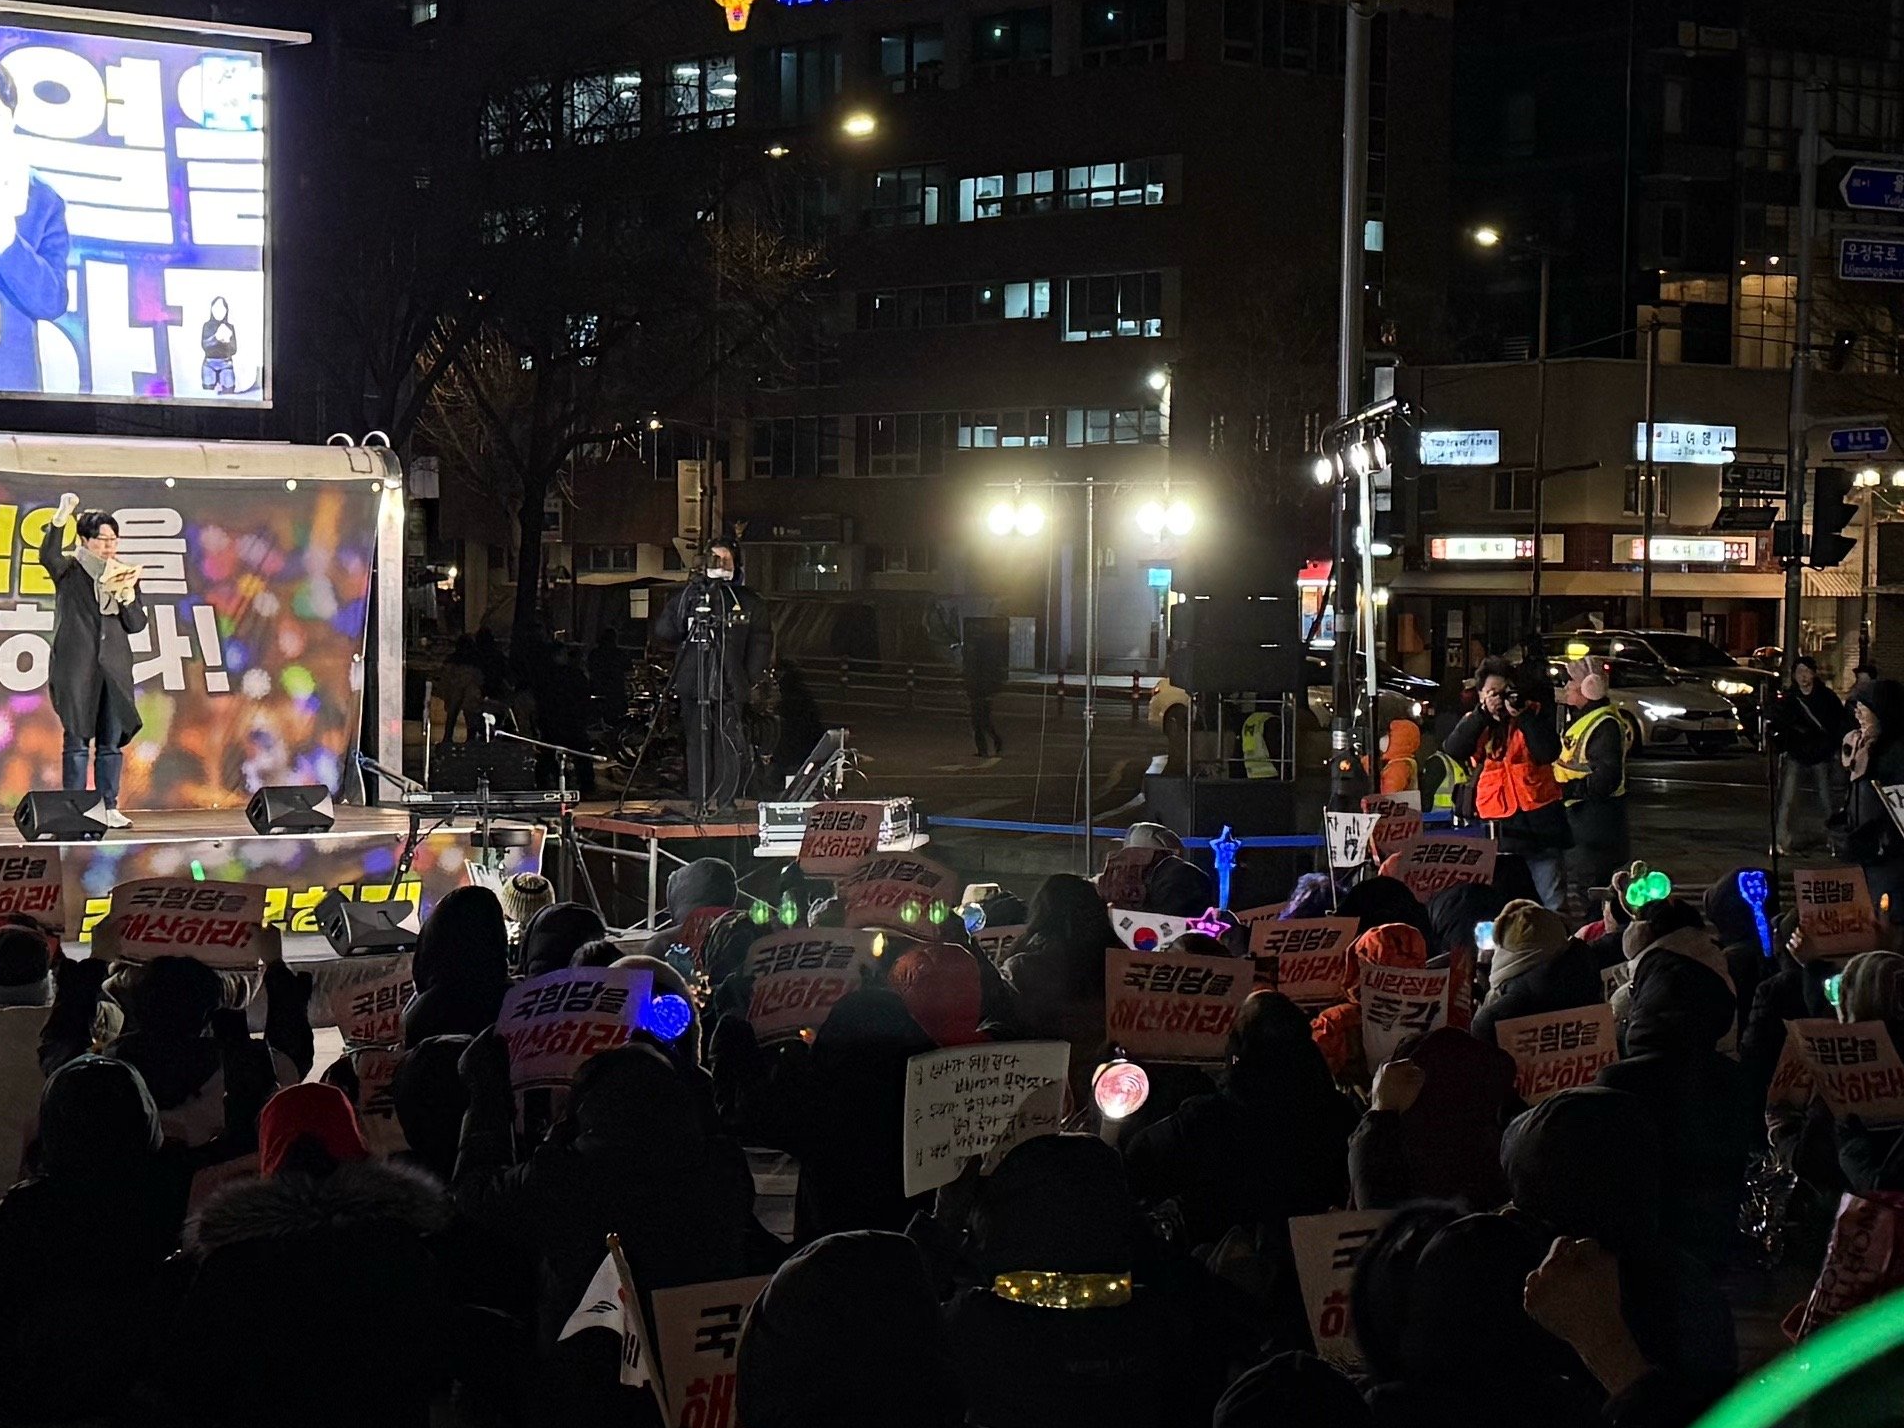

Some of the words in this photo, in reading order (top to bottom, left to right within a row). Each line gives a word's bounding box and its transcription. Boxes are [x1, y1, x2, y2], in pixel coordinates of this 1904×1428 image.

[1846, 244, 1898, 262] 우정국로
[131, 886, 247, 912] 국힘당을
[118, 914, 253, 948] 해산하라!
[1264, 928, 1342, 954] 국힘당을
[1123, 962, 1235, 997] 국힘당을
[511, 981, 630, 1020] 국힘당을
[1517, 1020, 1600, 1057] 국힘당을
